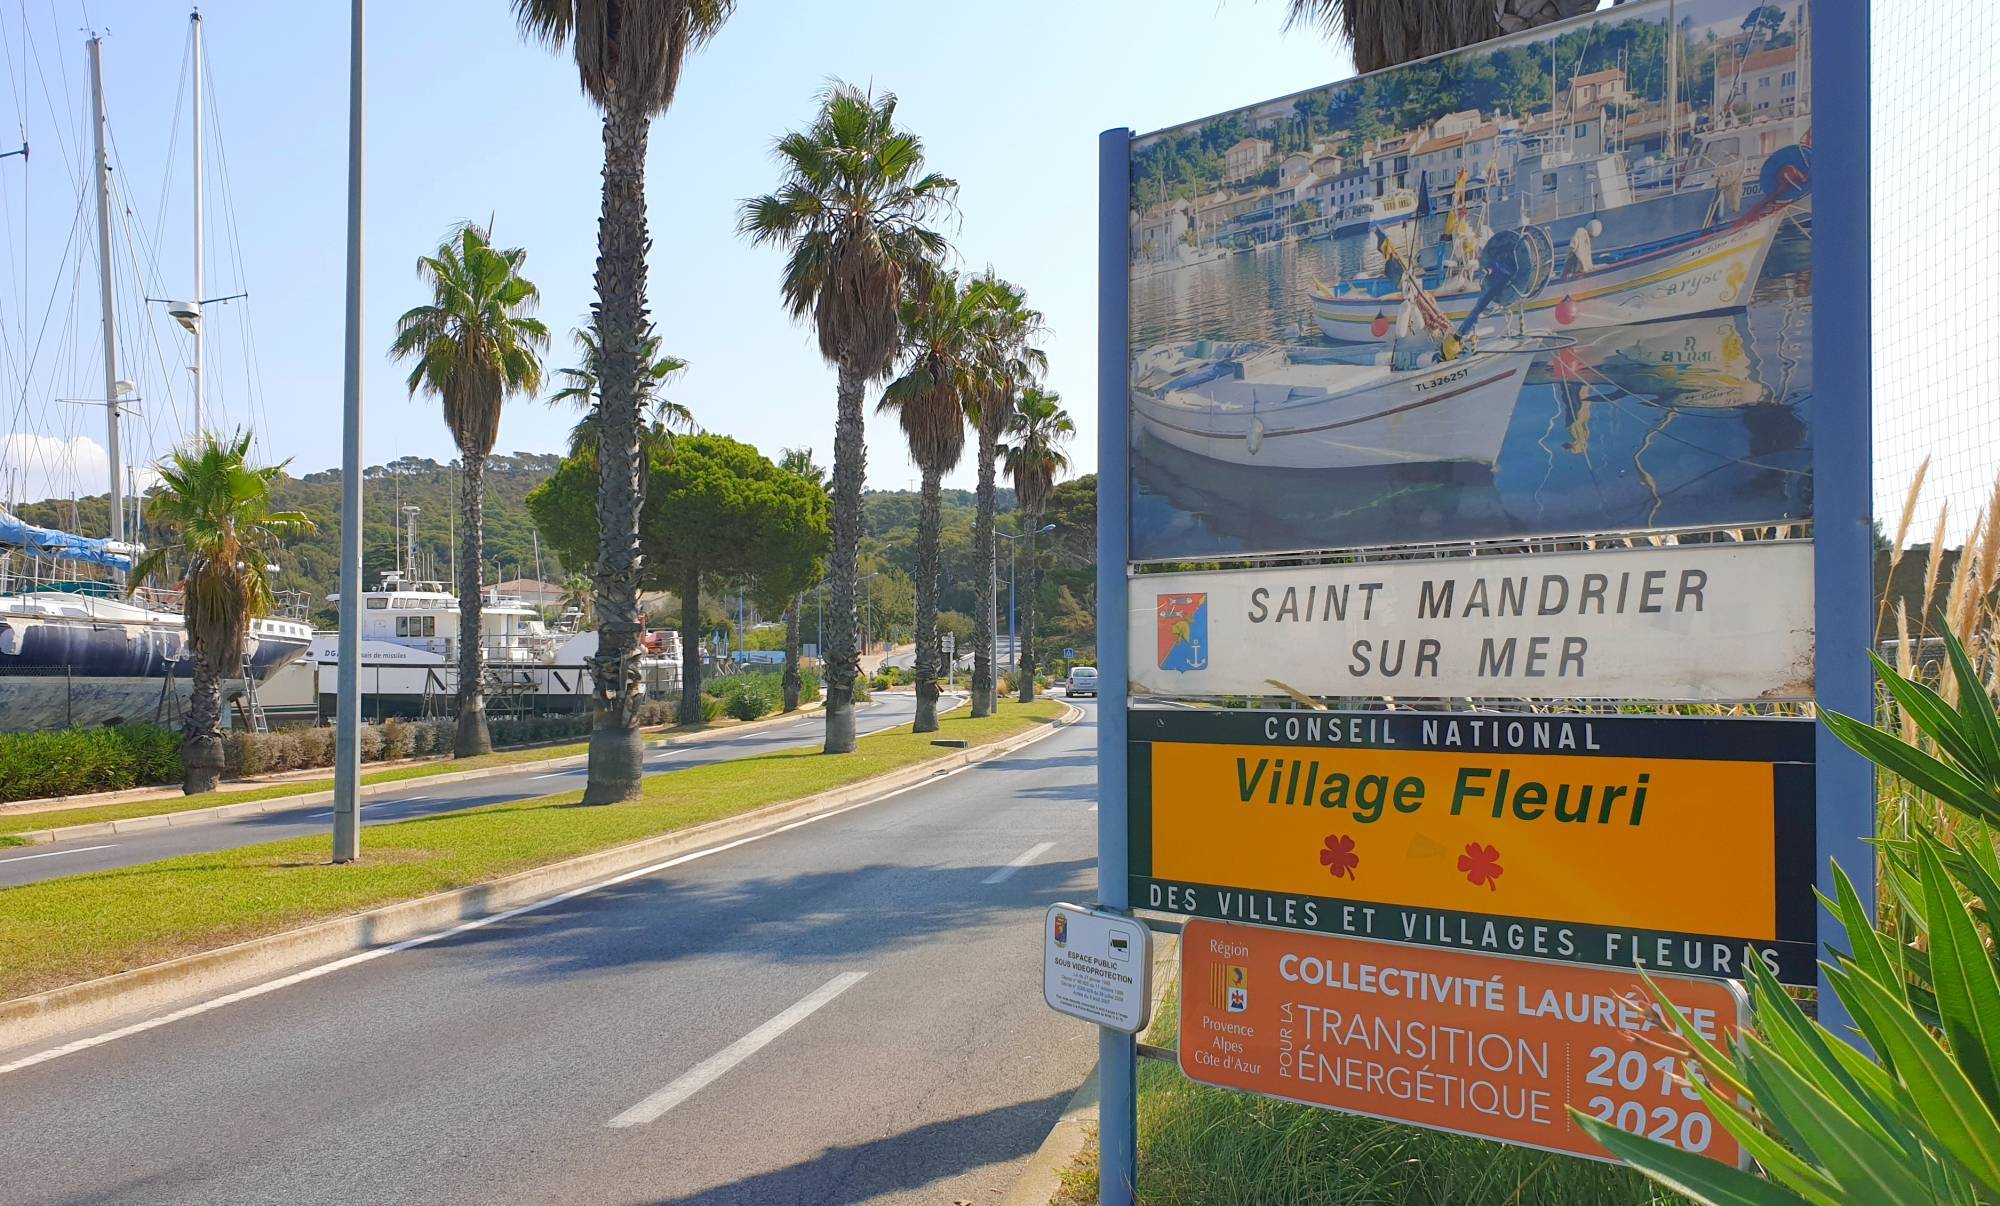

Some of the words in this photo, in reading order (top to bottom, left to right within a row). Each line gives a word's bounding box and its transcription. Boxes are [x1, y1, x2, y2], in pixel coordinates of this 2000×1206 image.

[1248, 582, 1384, 624] SAINT
[1417, 569, 1708, 619] MANDRIER
[324, 649, 339, 657] DG
[1348, 639, 1441, 678] SUR
[1477, 636, 1588, 678] MER
[1264, 716, 1396, 744] CONSEIL
[1422, 719, 1600, 750] NATIONAL
[1236, 757, 1425, 823] Village
[1450, 767, 1650, 826] Fleuri
[1150, 883, 1197, 912] DES
[1217, 891, 1319, 927] VILLES
[1343, 906, 1376, 934] ET
[1401, 911, 1575, 957] VILLAGES
[1606, 933, 1780, 978] FLEURIS
[1210, 938, 1249, 959] Région
[1054, 957, 1071, 968] SOUS
[1072, 962, 1133, 985] VIDEOPROTECTION
[1068, 951, 1092, 964] ESPACE
[1093, 956, 1118, 970] PUBLIC
[1279, 953, 1505, 1012] COLLECTIVITÉ
[1202, 1015, 1255, 1038] Provence
[1280, 1002, 1294, 1024] LA
[1212, 1035, 1244, 1054] Alpes
[1279, 1028, 1293, 1078] POUR
[1298, 1004, 1548, 1079] TRANSITION
[1194, 1049, 1220, 1067] Côte
[1223, 1055, 1262, 1075] d'Azur
[1299, 1044, 1552, 1125] ÉNERGÉTIQUE
[1588, 1095, 1712, 1153] 2020
